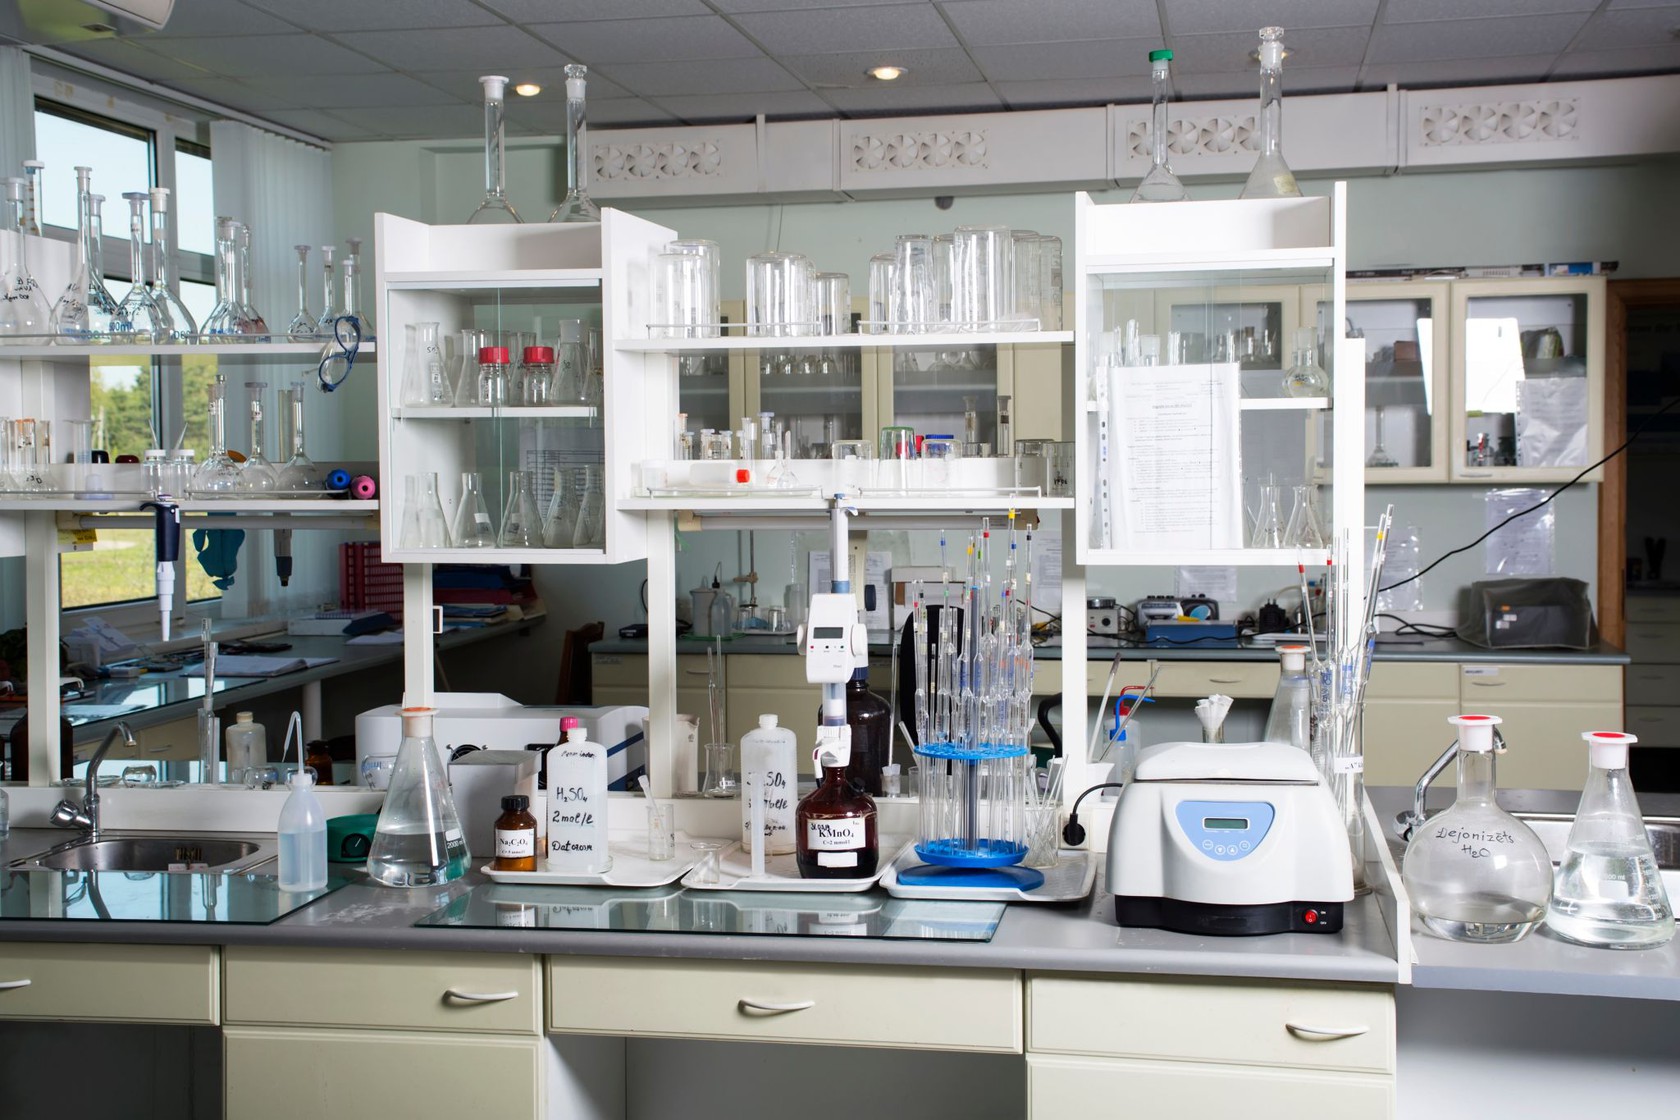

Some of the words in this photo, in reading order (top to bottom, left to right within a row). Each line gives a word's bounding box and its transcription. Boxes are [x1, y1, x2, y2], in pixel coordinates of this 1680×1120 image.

[556, 786, 588, 802] H2SO4
[818, 828, 854, 838] KMnO4
[1435, 827, 1515, 844] Dejonizēts
[499, 838, 528, 847] Na2C2O4
[1461, 844, 1491, 858] H2O
